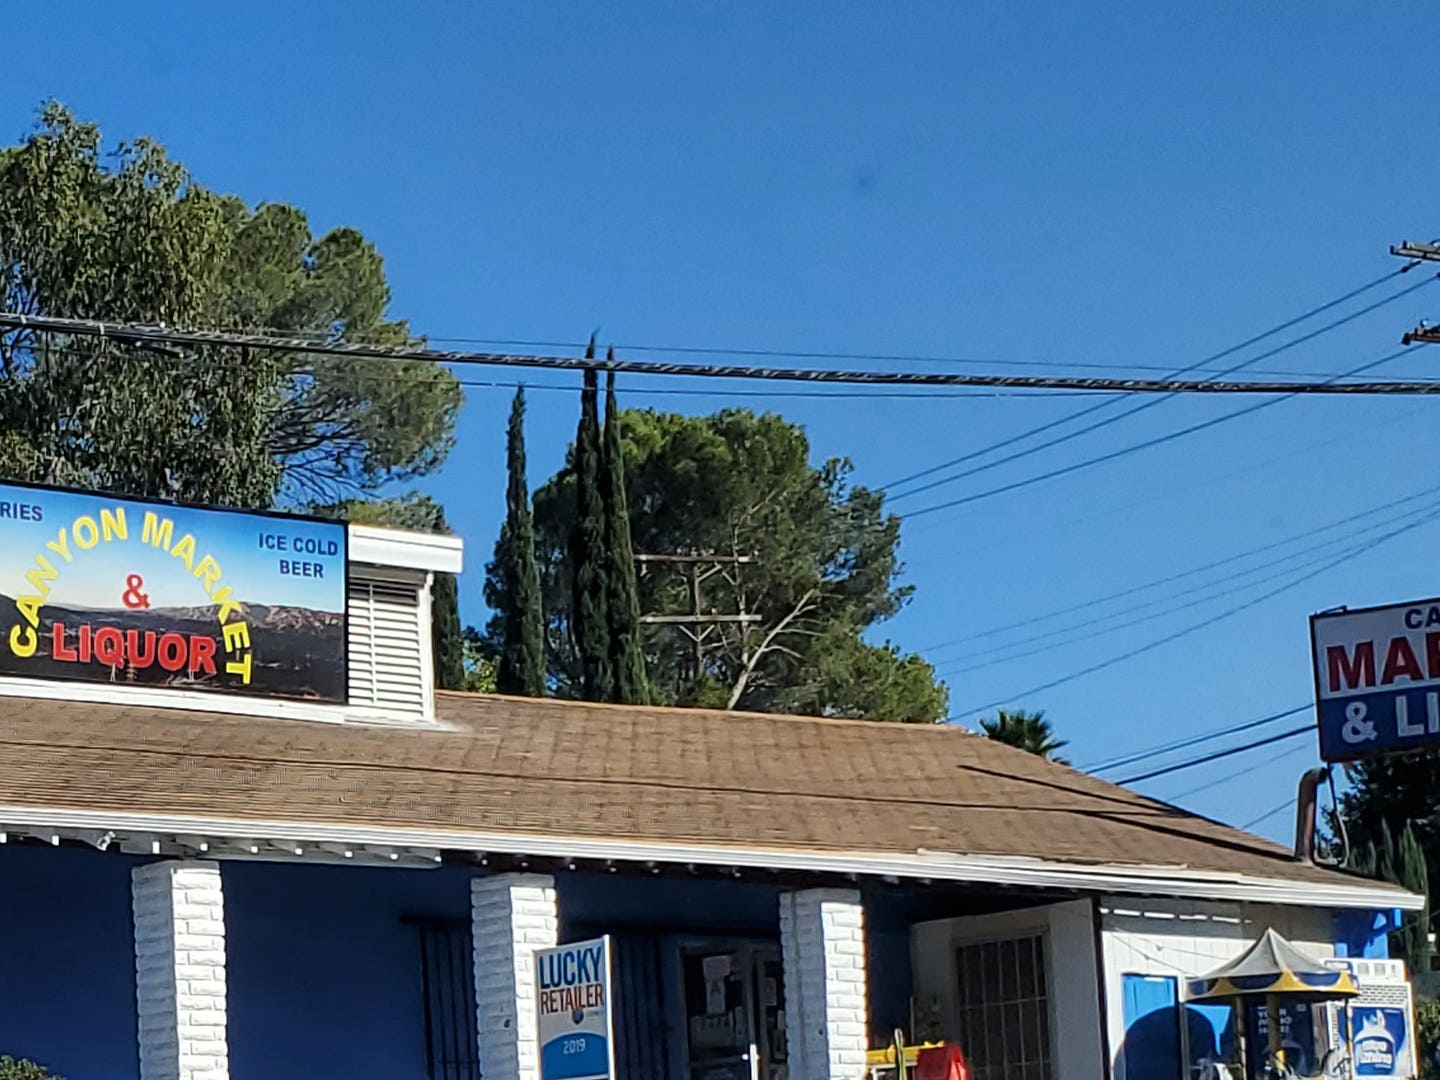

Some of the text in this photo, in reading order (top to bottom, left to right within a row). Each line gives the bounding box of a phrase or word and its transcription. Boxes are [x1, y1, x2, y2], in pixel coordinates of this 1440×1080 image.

[258, 532, 339, 557] ICE COLD
[279, 558, 324, 579] BEER
[9, 507, 253, 685] CANYON MARKET
[121, 573, 151, 610] &
[51, 621, 218, 674] LIQUOR
[1341, 701, 1378, 744] &
[539, 946, 602, 990] LUCKY
[540, 983, 605, 1016] RETAILER
[562, 1037, 587, 1055] 2019
